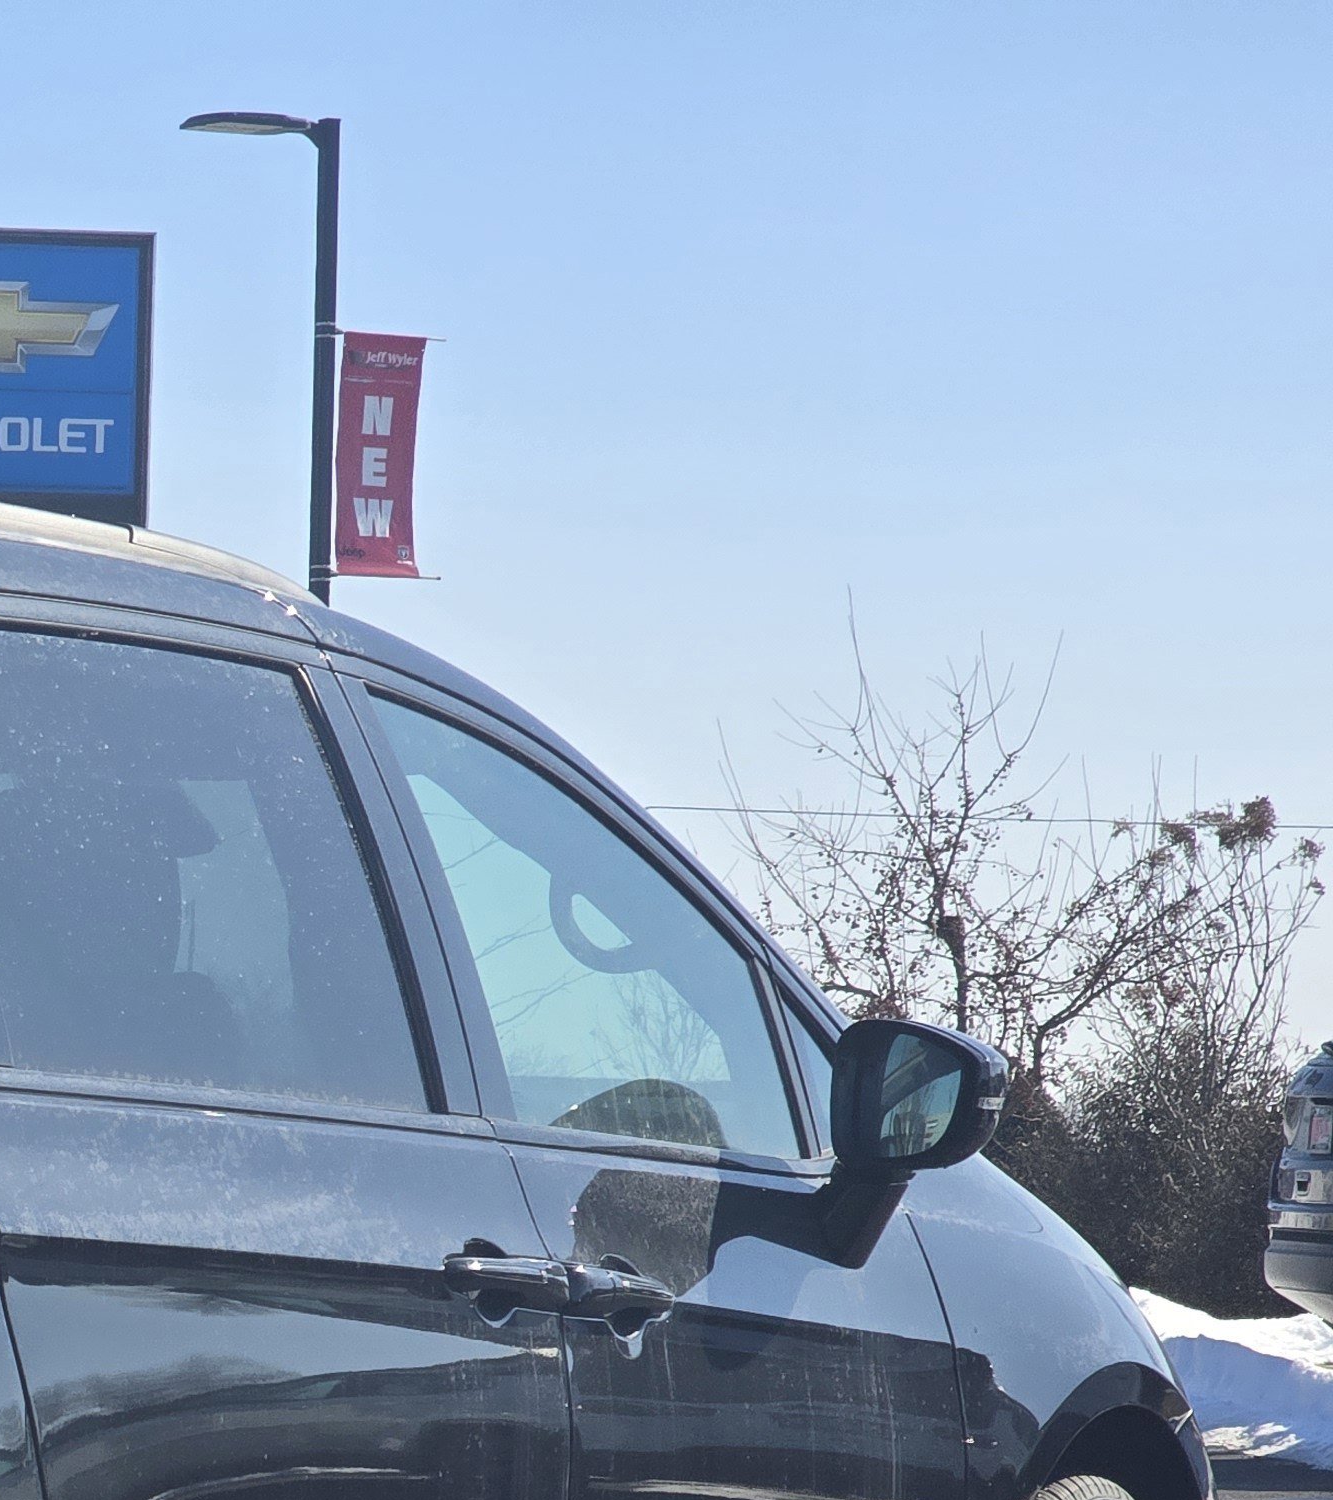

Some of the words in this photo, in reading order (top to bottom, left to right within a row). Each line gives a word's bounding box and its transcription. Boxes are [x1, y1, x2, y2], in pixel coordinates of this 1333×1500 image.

[366, 351, 388, 364] Jeff
[388, 353, 420, 367] Wyler
[353, 395, 394, 538] NEW
